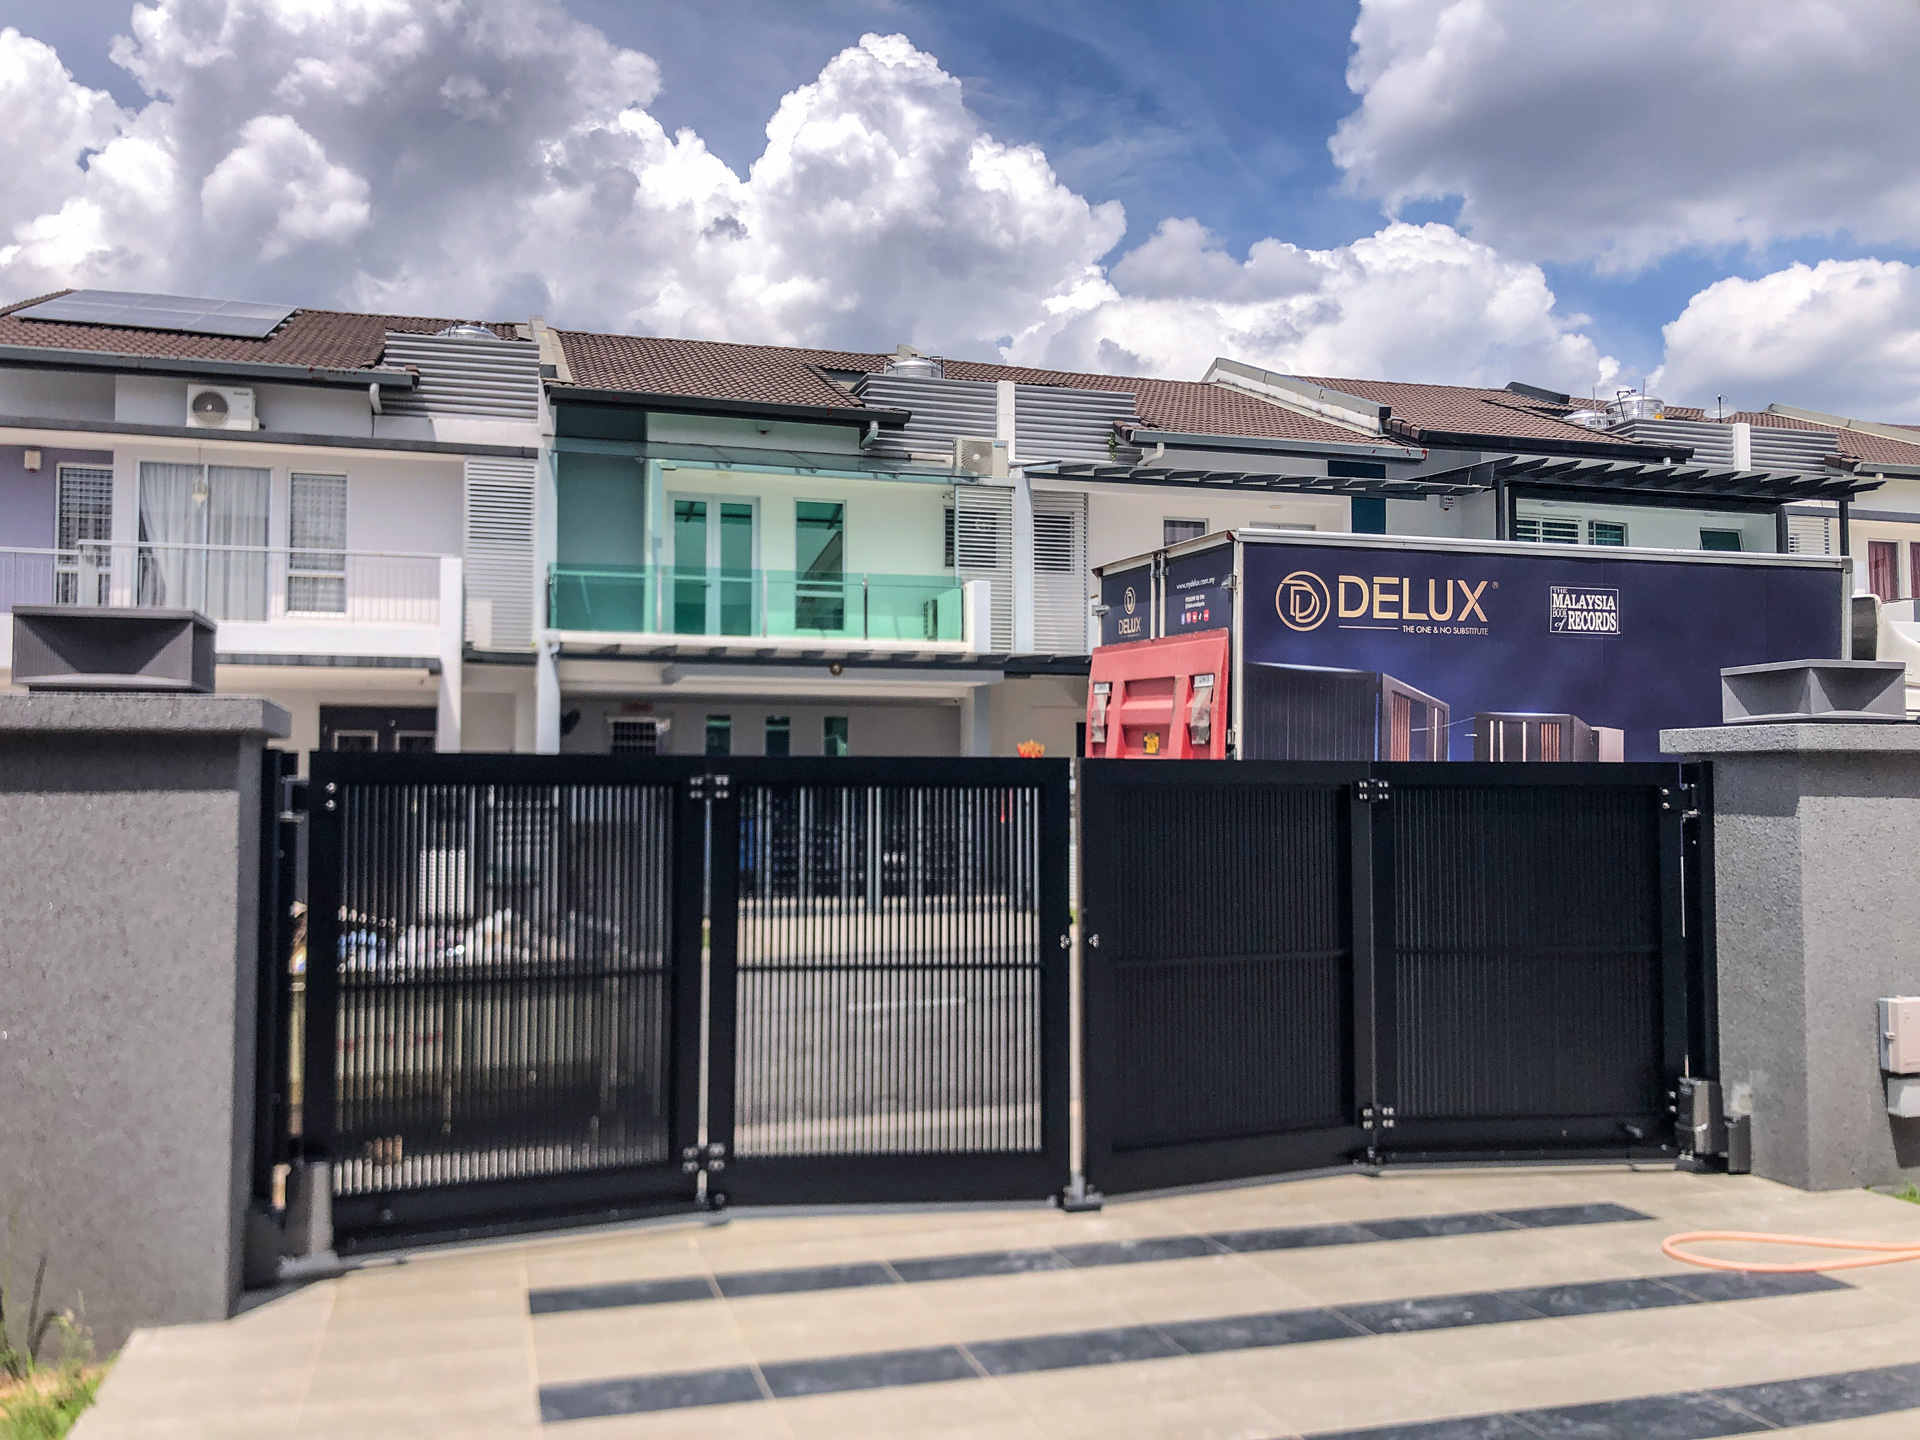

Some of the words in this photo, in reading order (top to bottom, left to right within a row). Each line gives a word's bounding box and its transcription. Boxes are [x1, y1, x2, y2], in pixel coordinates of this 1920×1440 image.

[1338, 575, 1489, 623] DELUX
[1552, 593, 1616, 610] MALAYSIA
[1552, 608, 1568, 618] BOOK
[1554, 617, 1568, 632] of
[1567, 610, 1617, 632] RECORDS
[1118, 617, 1142, 635] DELUX
[1402, 625, 1415, 634] THE
[1415, 625, 1432, 634] ONE
[1433, 626, 1439, 634] &
[1440, 626, 1452, 635] NO
[1453, 627, 1489, 636] SUBSTITUTE
